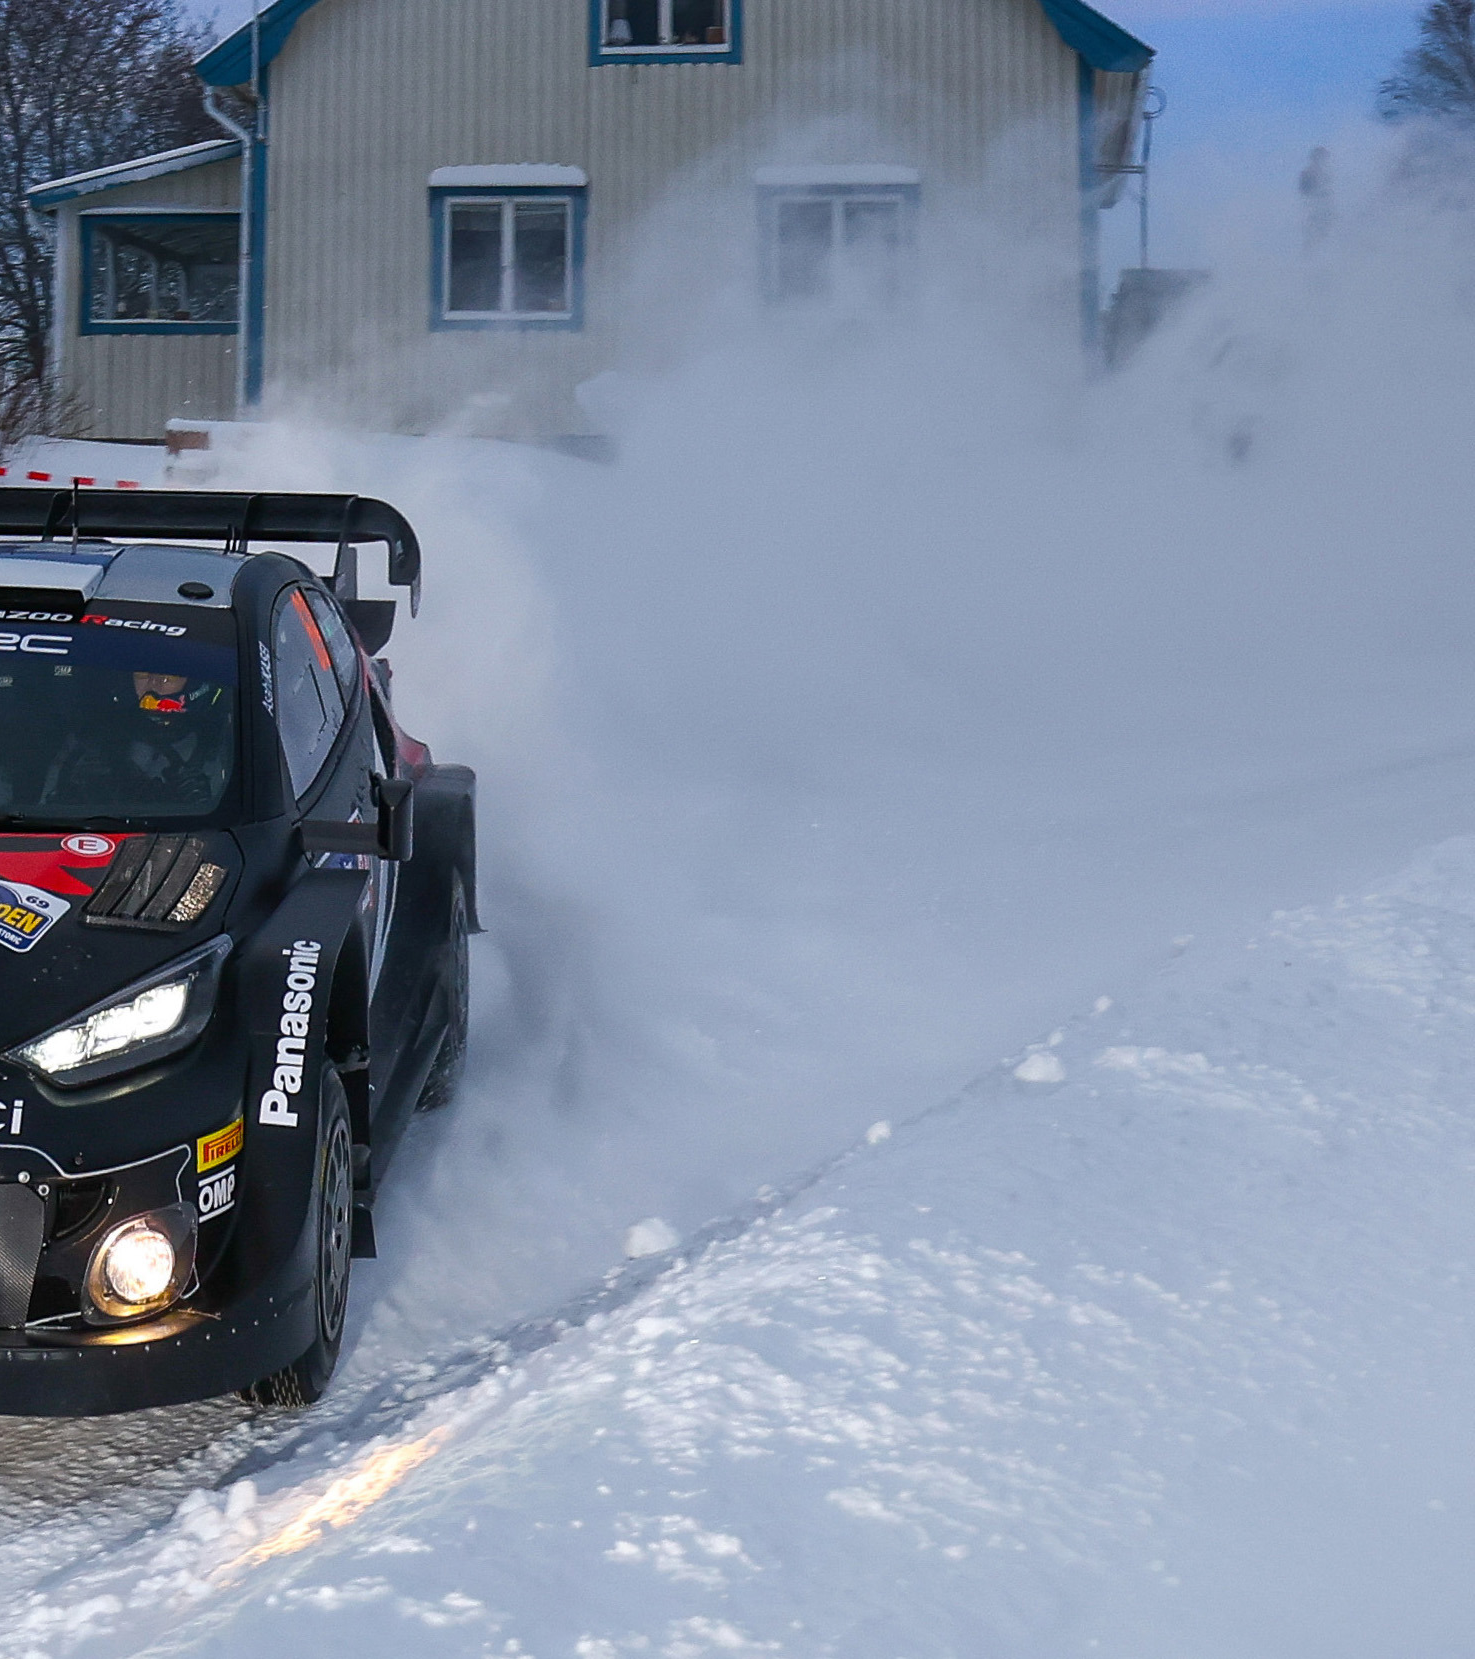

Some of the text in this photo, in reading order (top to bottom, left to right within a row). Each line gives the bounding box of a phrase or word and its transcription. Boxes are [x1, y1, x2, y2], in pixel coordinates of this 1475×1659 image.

[79, 613, 187, 637] Racing
[259, 940, 321, 1127] Panasonic
[199, 1174, 235, 1213] OMP
